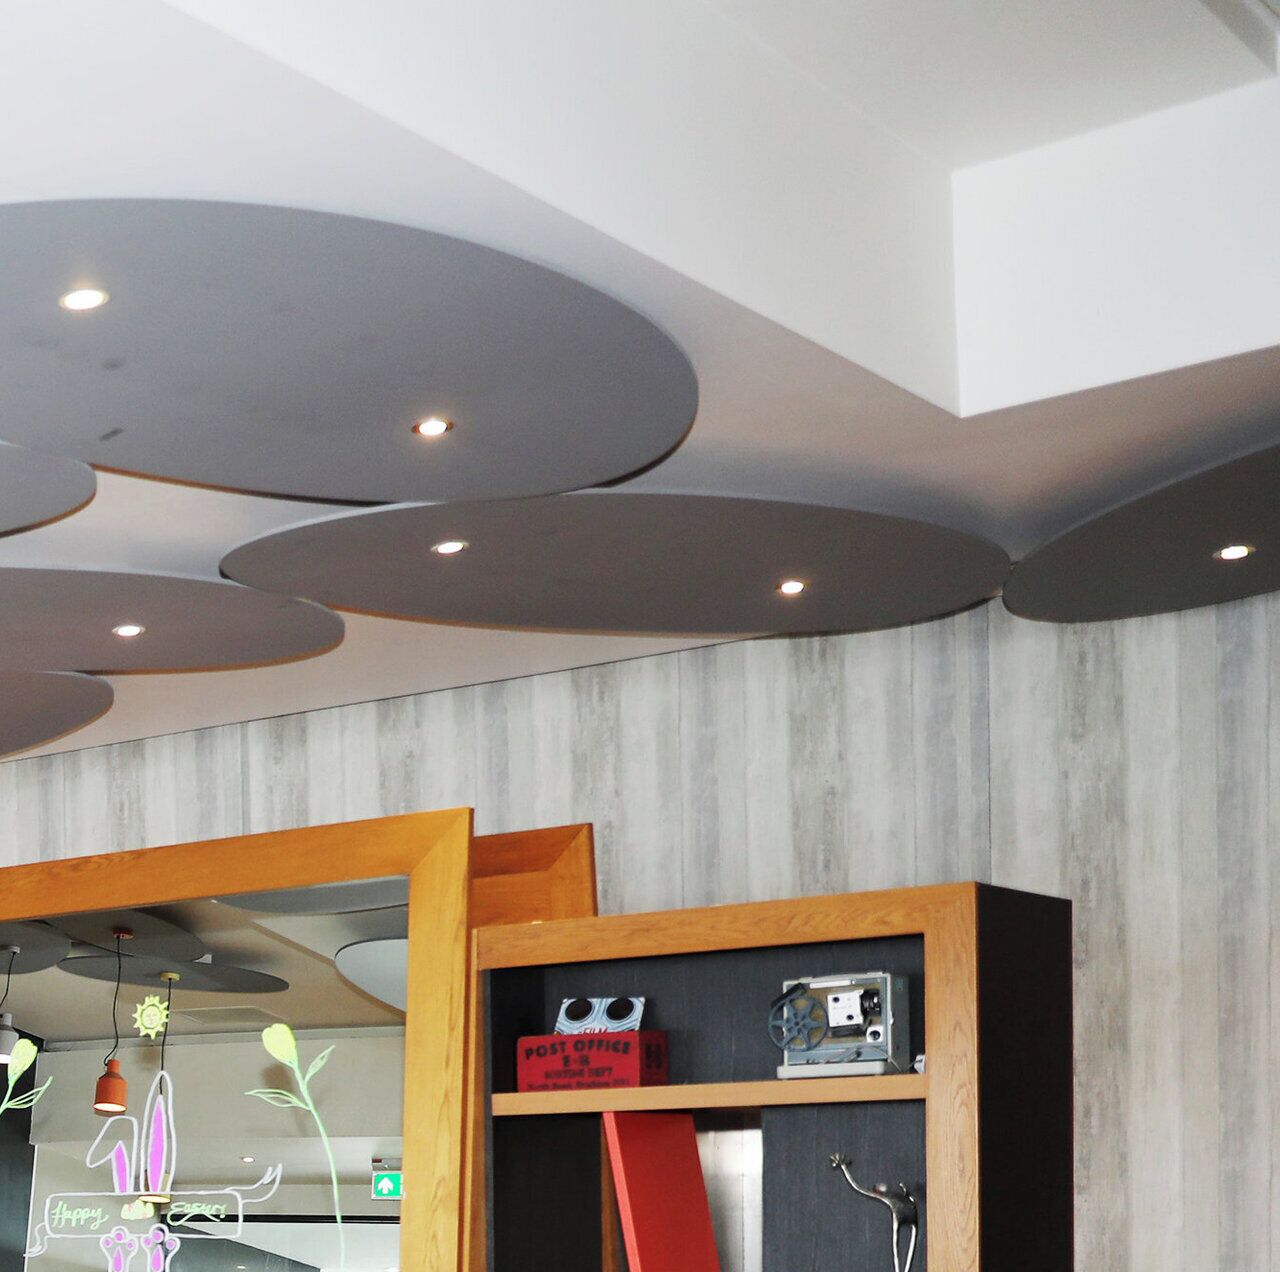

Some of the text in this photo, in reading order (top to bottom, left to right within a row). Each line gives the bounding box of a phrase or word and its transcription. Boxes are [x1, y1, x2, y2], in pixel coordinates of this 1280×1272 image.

[524, 1039, 632, 1060] POST OFFICE
[51, 1200, 109, 1230] Happy
